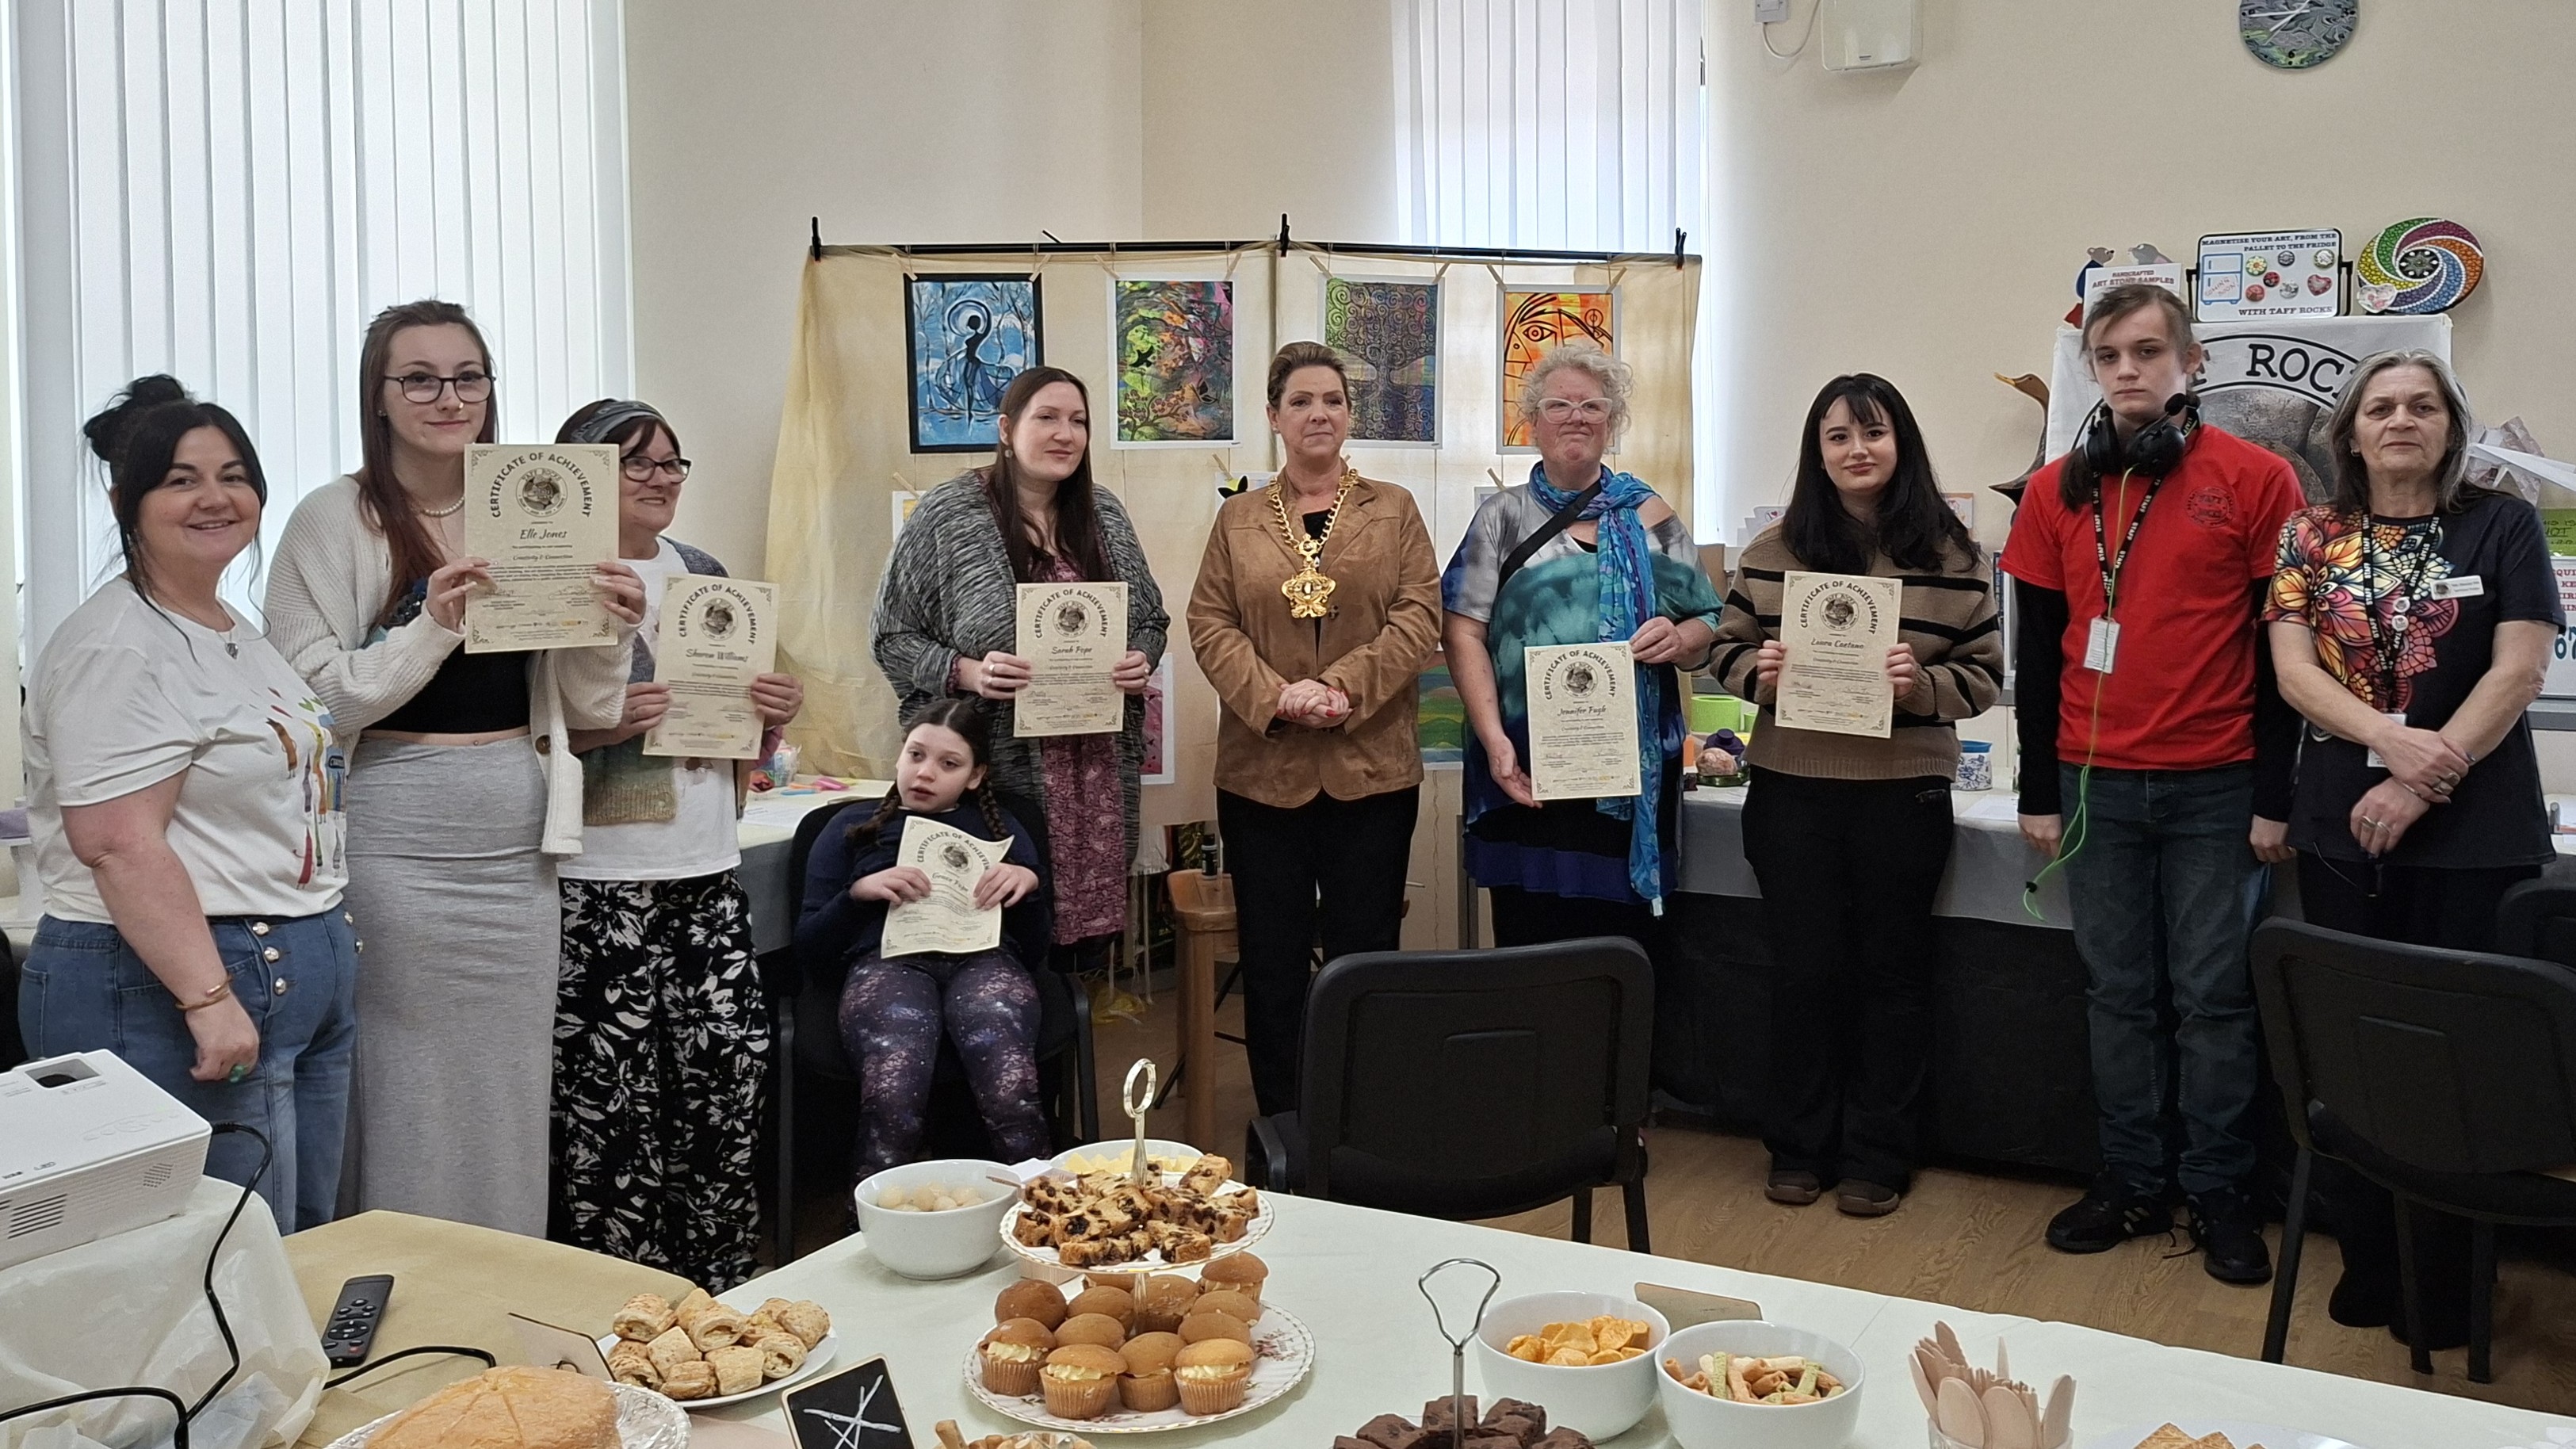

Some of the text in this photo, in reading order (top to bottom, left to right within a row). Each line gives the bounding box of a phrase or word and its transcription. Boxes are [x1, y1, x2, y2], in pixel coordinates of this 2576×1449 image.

[2245, 343, 2356, 400] ROC
[490, 452, 593, 518] CERTIFICATE OF ACHIEVEMENT
[2138, 495, 2152, 512] STAFF
[520, 529, 568, 540] Elle Jones
[2127, 522, 2138, 541] STAFF
[2429, 517, 2440, 533] STAFF
[2096, 542, 2105, 562] STAFF
[2420, 543, 2430, 561] STAFF
[2409, 570, 2420, 587] STAFF
[2364, 587, 2373, 605] STAFF
[678, 583, 758, 644] CERTIFICATE OF ACHIEVEMENT
[1034, 591, 1061, 638] CERTIFICATE
[1076, 590, 1108, 638] ACHIEVEMENT
[1800, 582, 1829, 629] CERTIFICATE
[1847, 583, 1878, 635] ACHIEVEMENT
[2369, 617, 2379, 638] STAFF
[1051, 645, 1073, 655] Sarah
[1544, 653, 1567, 700] CERTIFICATE
[1583, 651, 1616, 698] ACHIEVEMENT
[1557, 707, 1587, 717] Jennifer
[917, 832, 950, 862] CERTIFICATE
